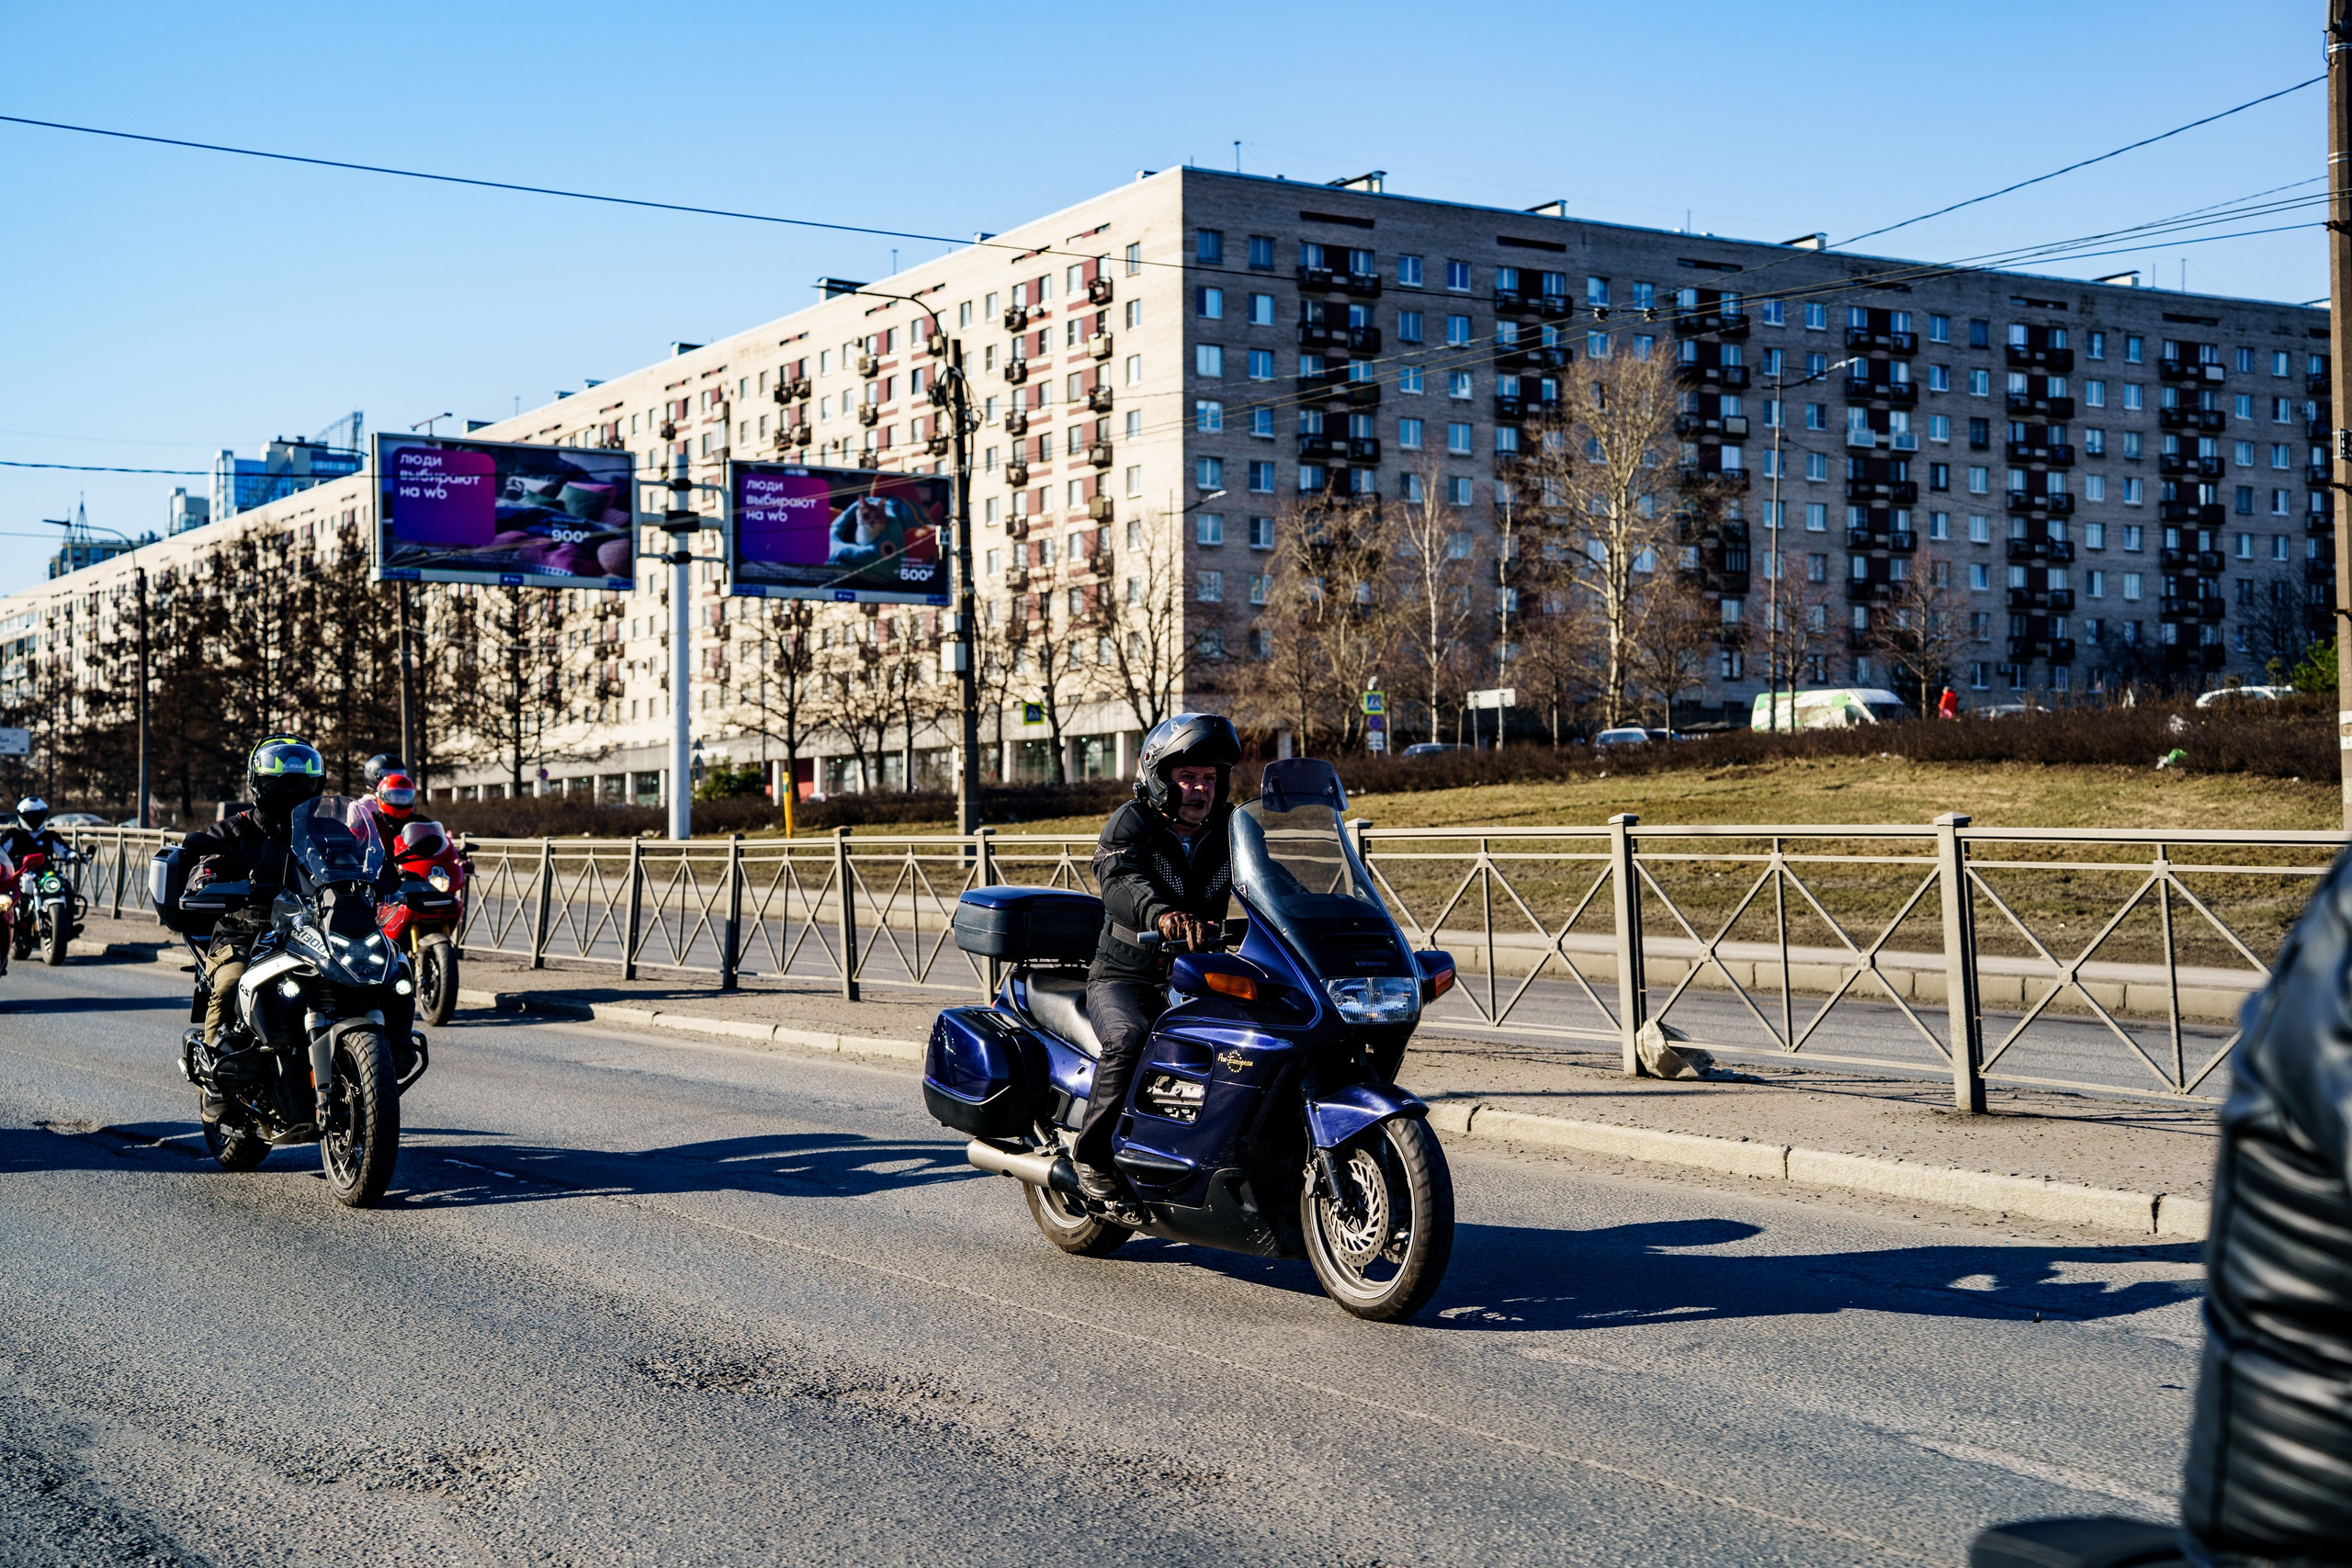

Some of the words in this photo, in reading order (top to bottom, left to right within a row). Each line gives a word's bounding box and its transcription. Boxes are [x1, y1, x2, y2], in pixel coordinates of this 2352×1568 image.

[400, 454, 443, 468] люди
[400, 468, 481, 486] выбирают
[400, 486, 421, 498] на
[423, 484, 448, 500] wb
[746, 479, 784, 492] люди
[746, 492, 818, 511] выбирают
[746, 510, 764, 521] на
[766, 508, 788, 523] wb
[239, 984, 251, 998] GS
